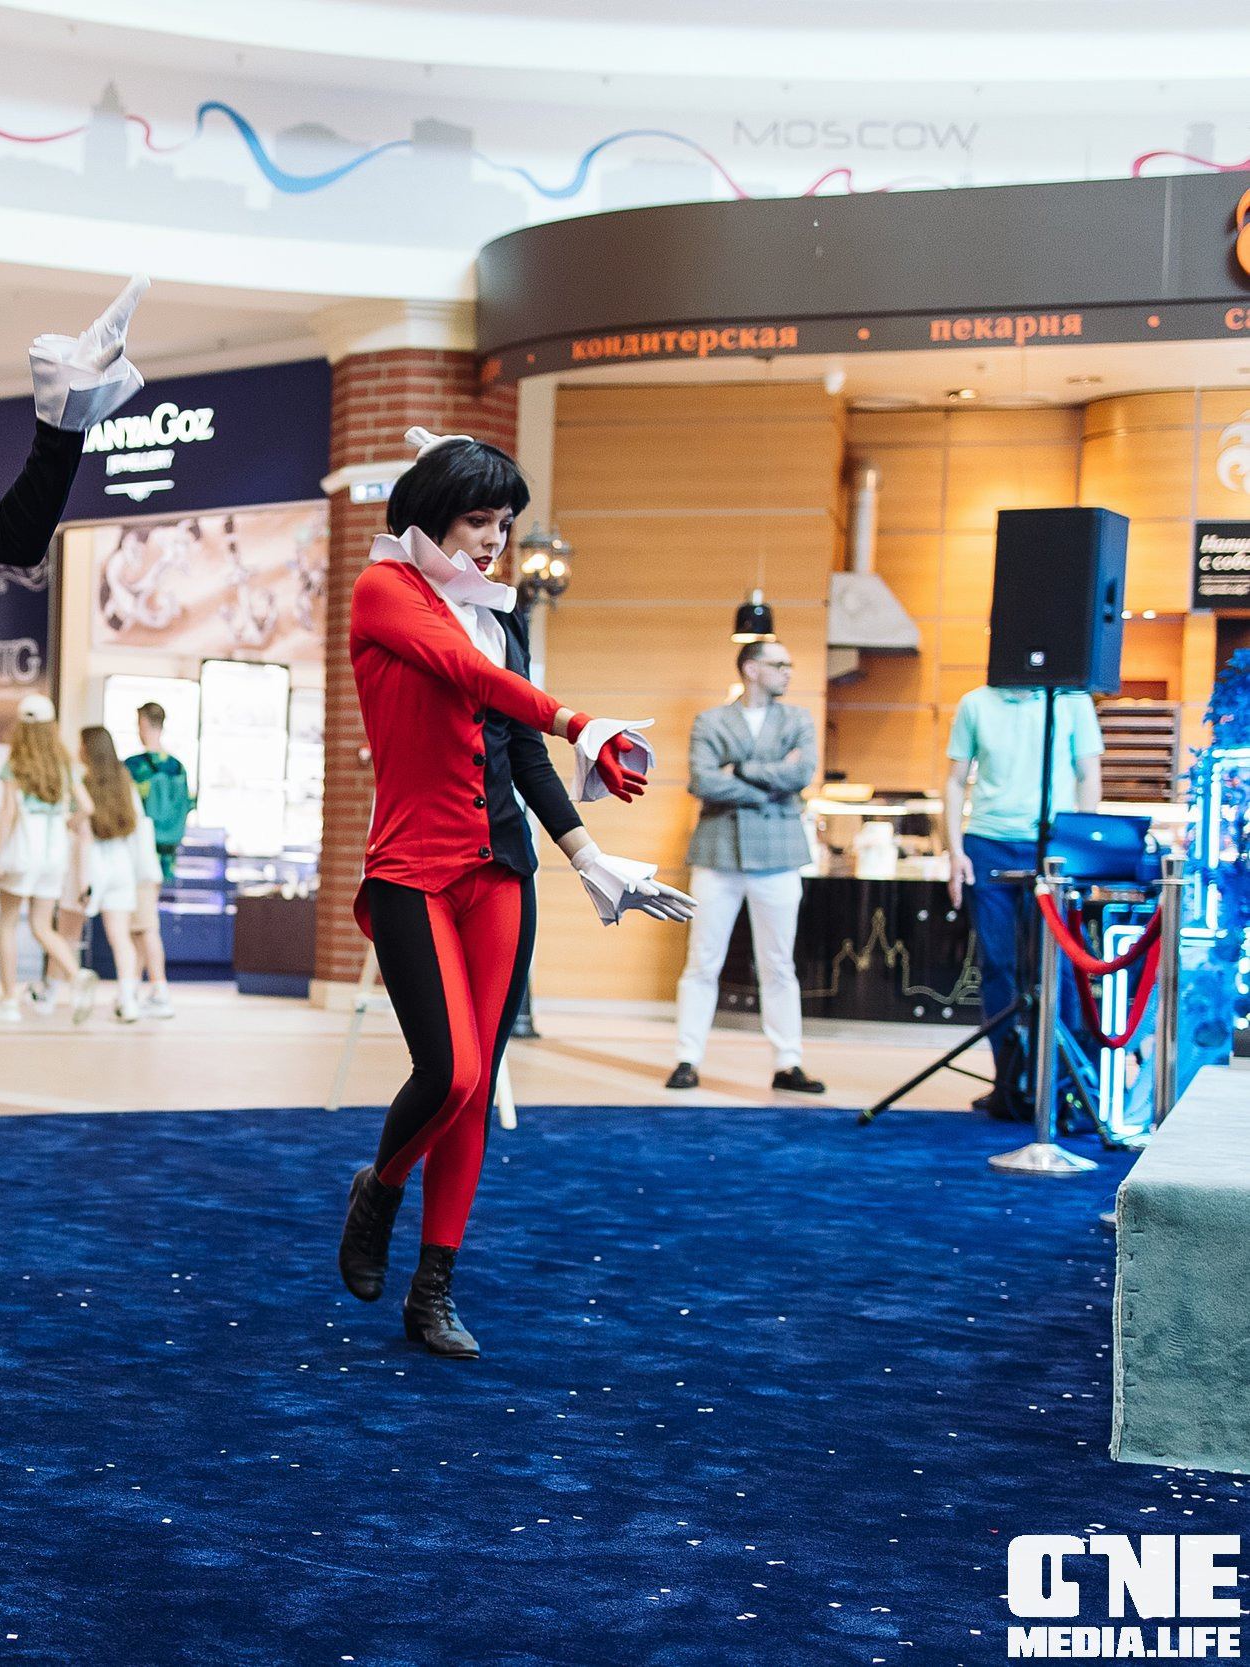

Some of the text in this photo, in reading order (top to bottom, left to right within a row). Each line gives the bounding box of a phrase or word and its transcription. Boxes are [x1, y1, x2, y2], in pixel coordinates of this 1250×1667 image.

[733, 119, 979, 151] MOSCOW
[572, 314, 1082, 359] кондитерская пекарня
